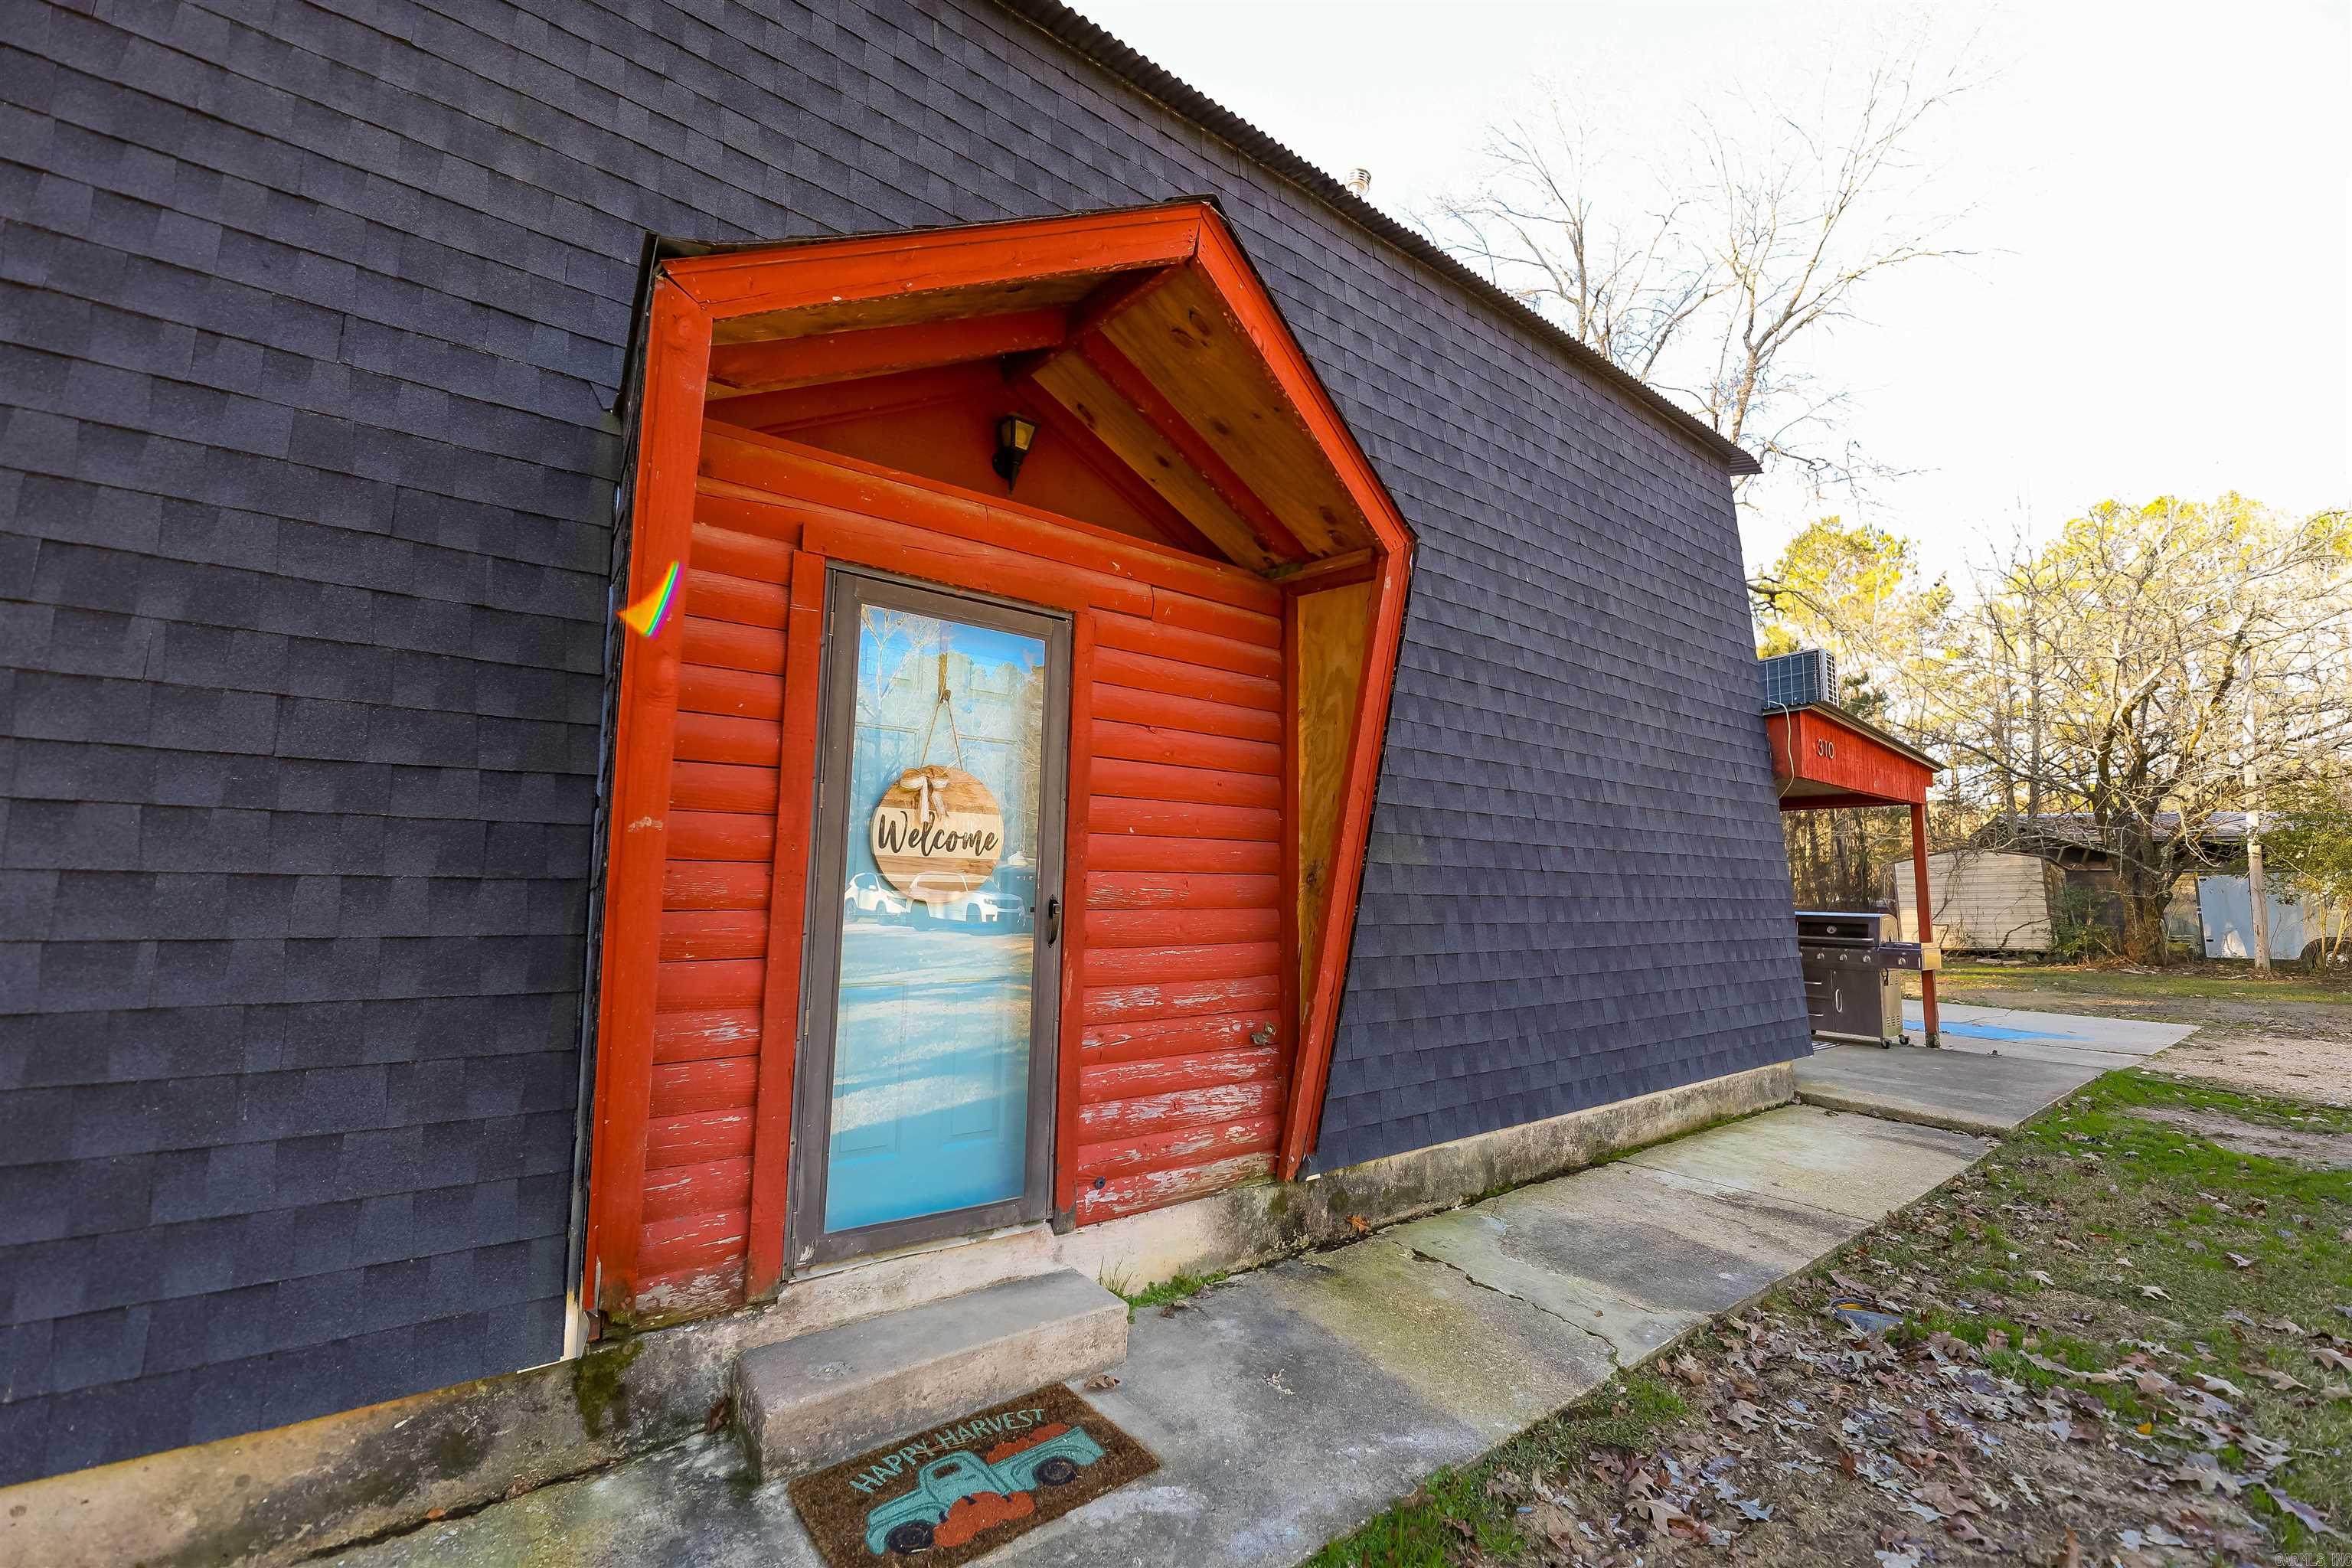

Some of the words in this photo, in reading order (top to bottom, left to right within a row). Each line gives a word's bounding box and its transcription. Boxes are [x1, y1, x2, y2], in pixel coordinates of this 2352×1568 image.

[1818, 738, 1834, 759] 310
[877, 810, 998, 857] Welcome
[849, 1438, 935, 1494] HAPPY
[935, 1408, 1046, 1449] HARVEST
